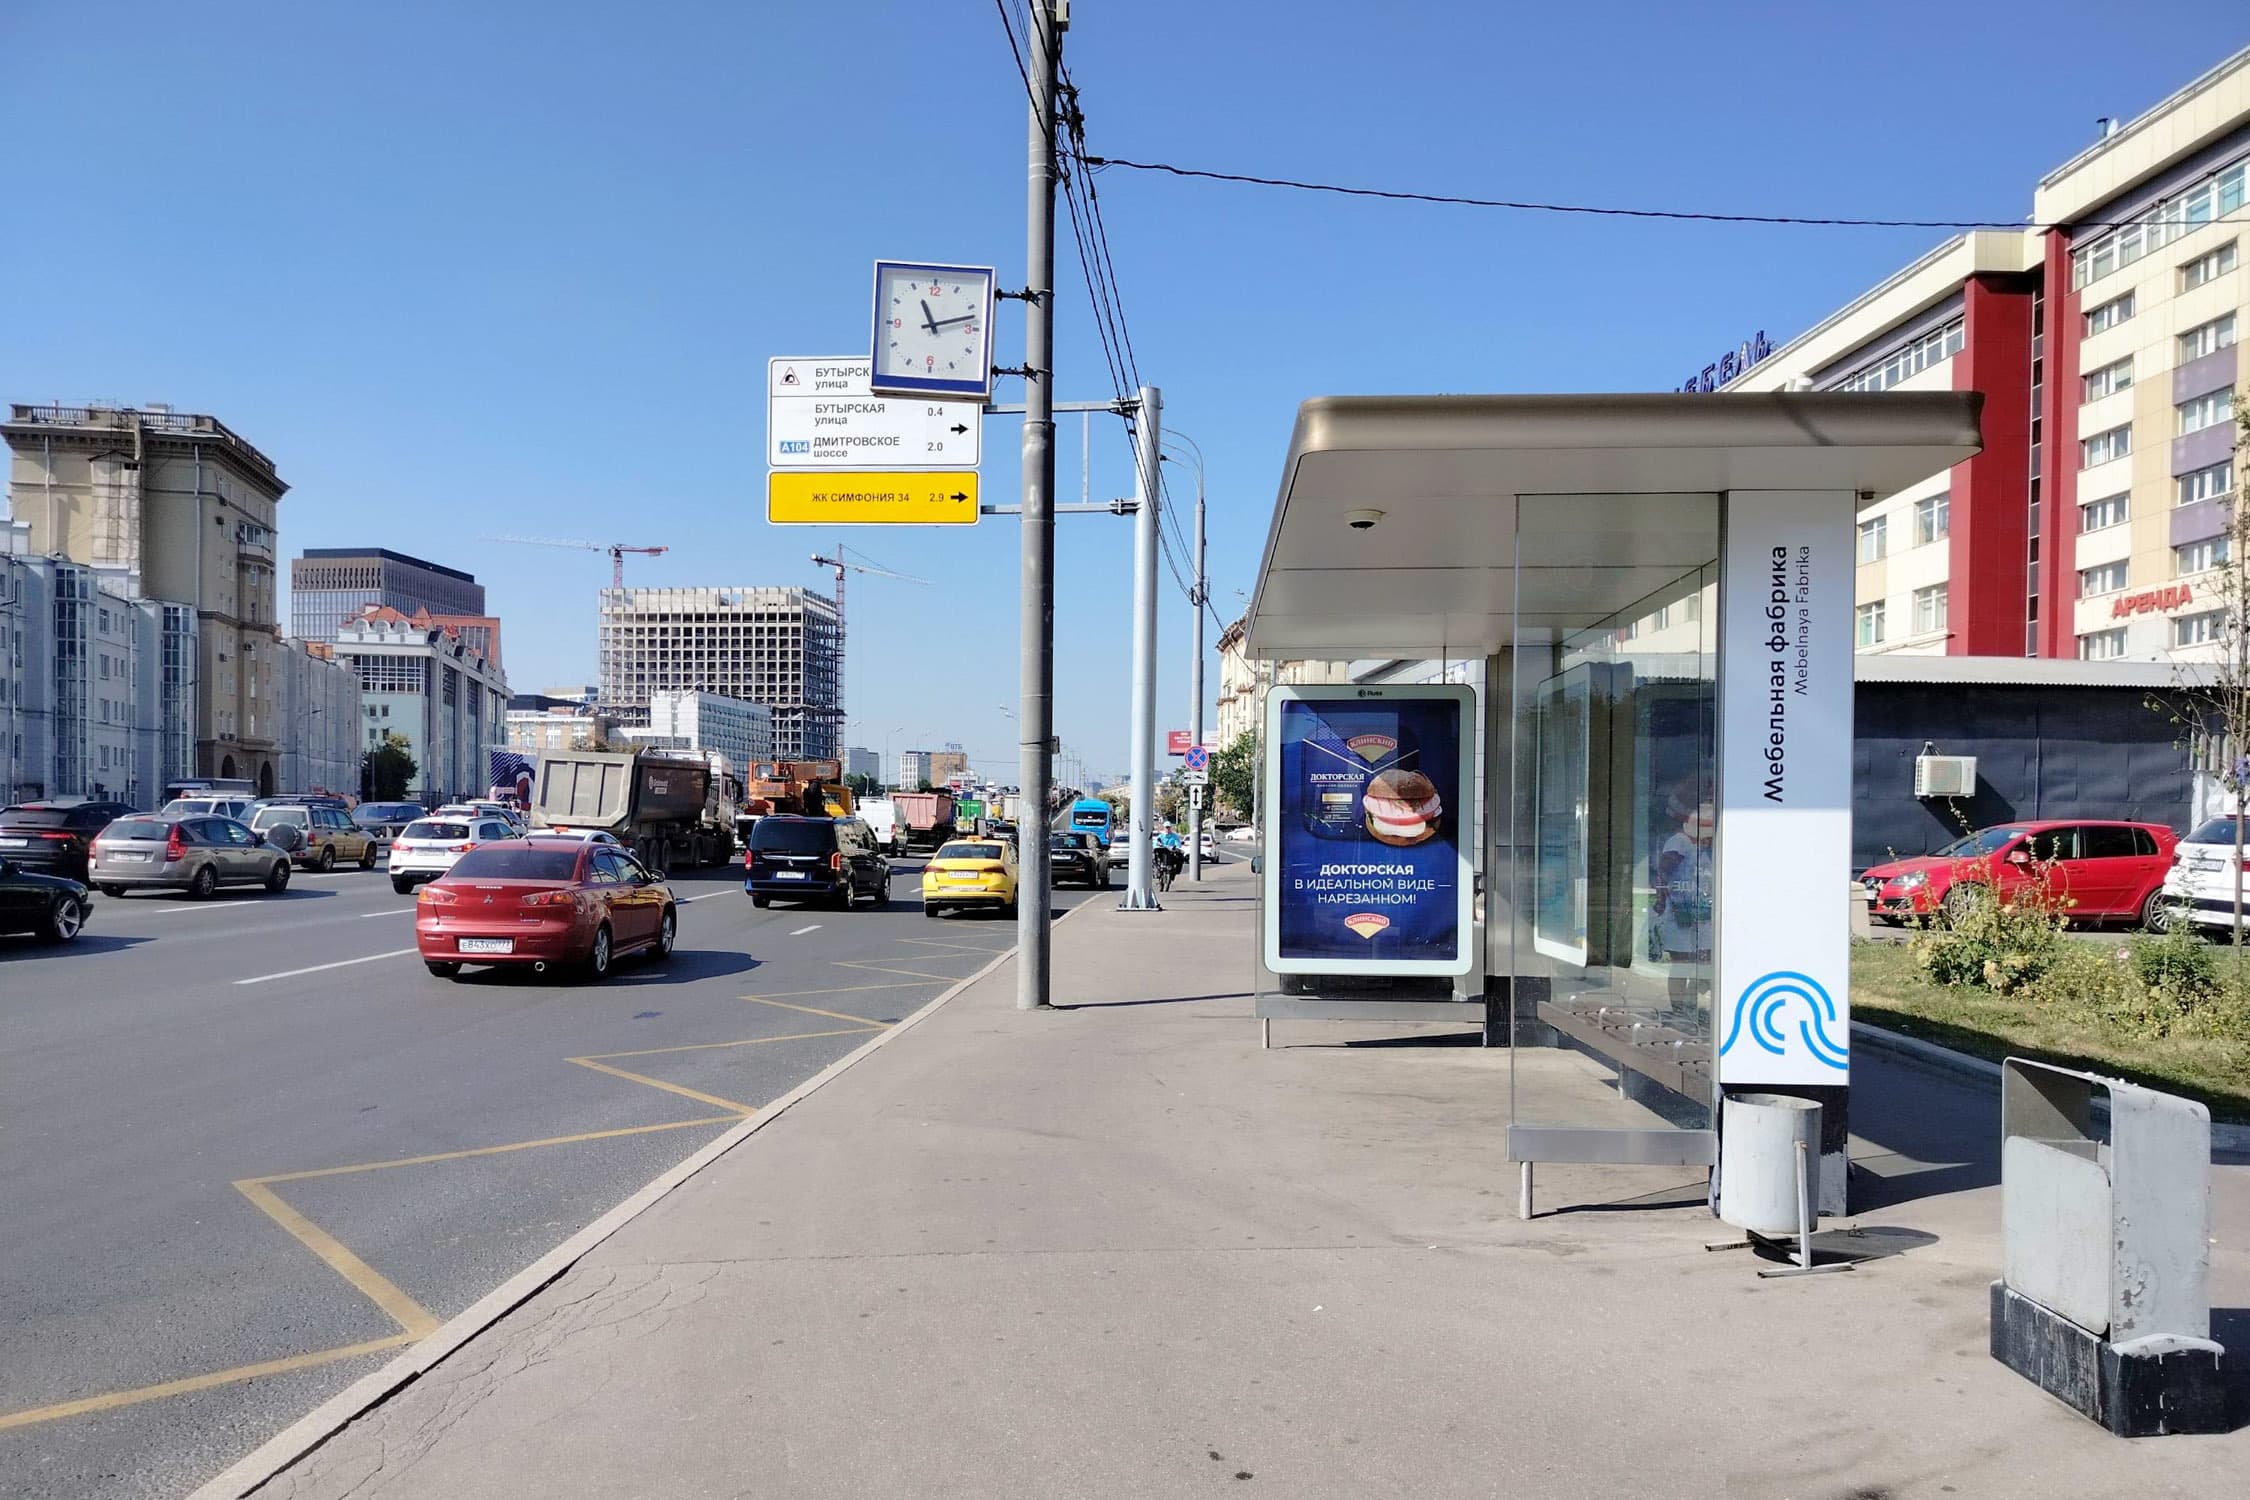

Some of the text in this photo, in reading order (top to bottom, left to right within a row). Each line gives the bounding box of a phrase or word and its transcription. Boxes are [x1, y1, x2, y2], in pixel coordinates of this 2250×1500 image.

[929, 286, 941, 297] 12
[893, 318, 972, 334] 9 3
[926, 355, 935, 366] 6
[1675, 330, 1772, 393] ЕБЕЛЬ
[815, 367, 870, 378] БУТЫРСК
[815, 380, 849, 390] улица
[815, 403, 943, 417] БУТЫРСКАЯ 0.4
[814, 416, 848, 427] улица
[813, 436, 900, 448] ДМИТРОВСКОЕ
[927, 441, 943, 452] 2.0
[813, 449, 848, 458] шоссе
[812, 492, 945, 503] ЖК СИМФОНИЯ 34 2.9
[2112, 583, 2193, 620] АРЕНДА
[1793, 545, 1812, 696] Mebelnaya Fabrika
[1763, 546, 1790, 803] Мебельная фабрика
[1310, 773, 1365, 782] ДОКТОРСКАЯ
[1319, 864, 1414, 876] ДОКТОРСКАЯ
[1294, 879, 1304, 889] В
[1306, 879, 1394, 890] ИДЕАЛЬНОМ
[1397, 879, 1435, 890] ВИДЕ
[1318, 893, 1417, 905] НАРЕЗАННОМ!
